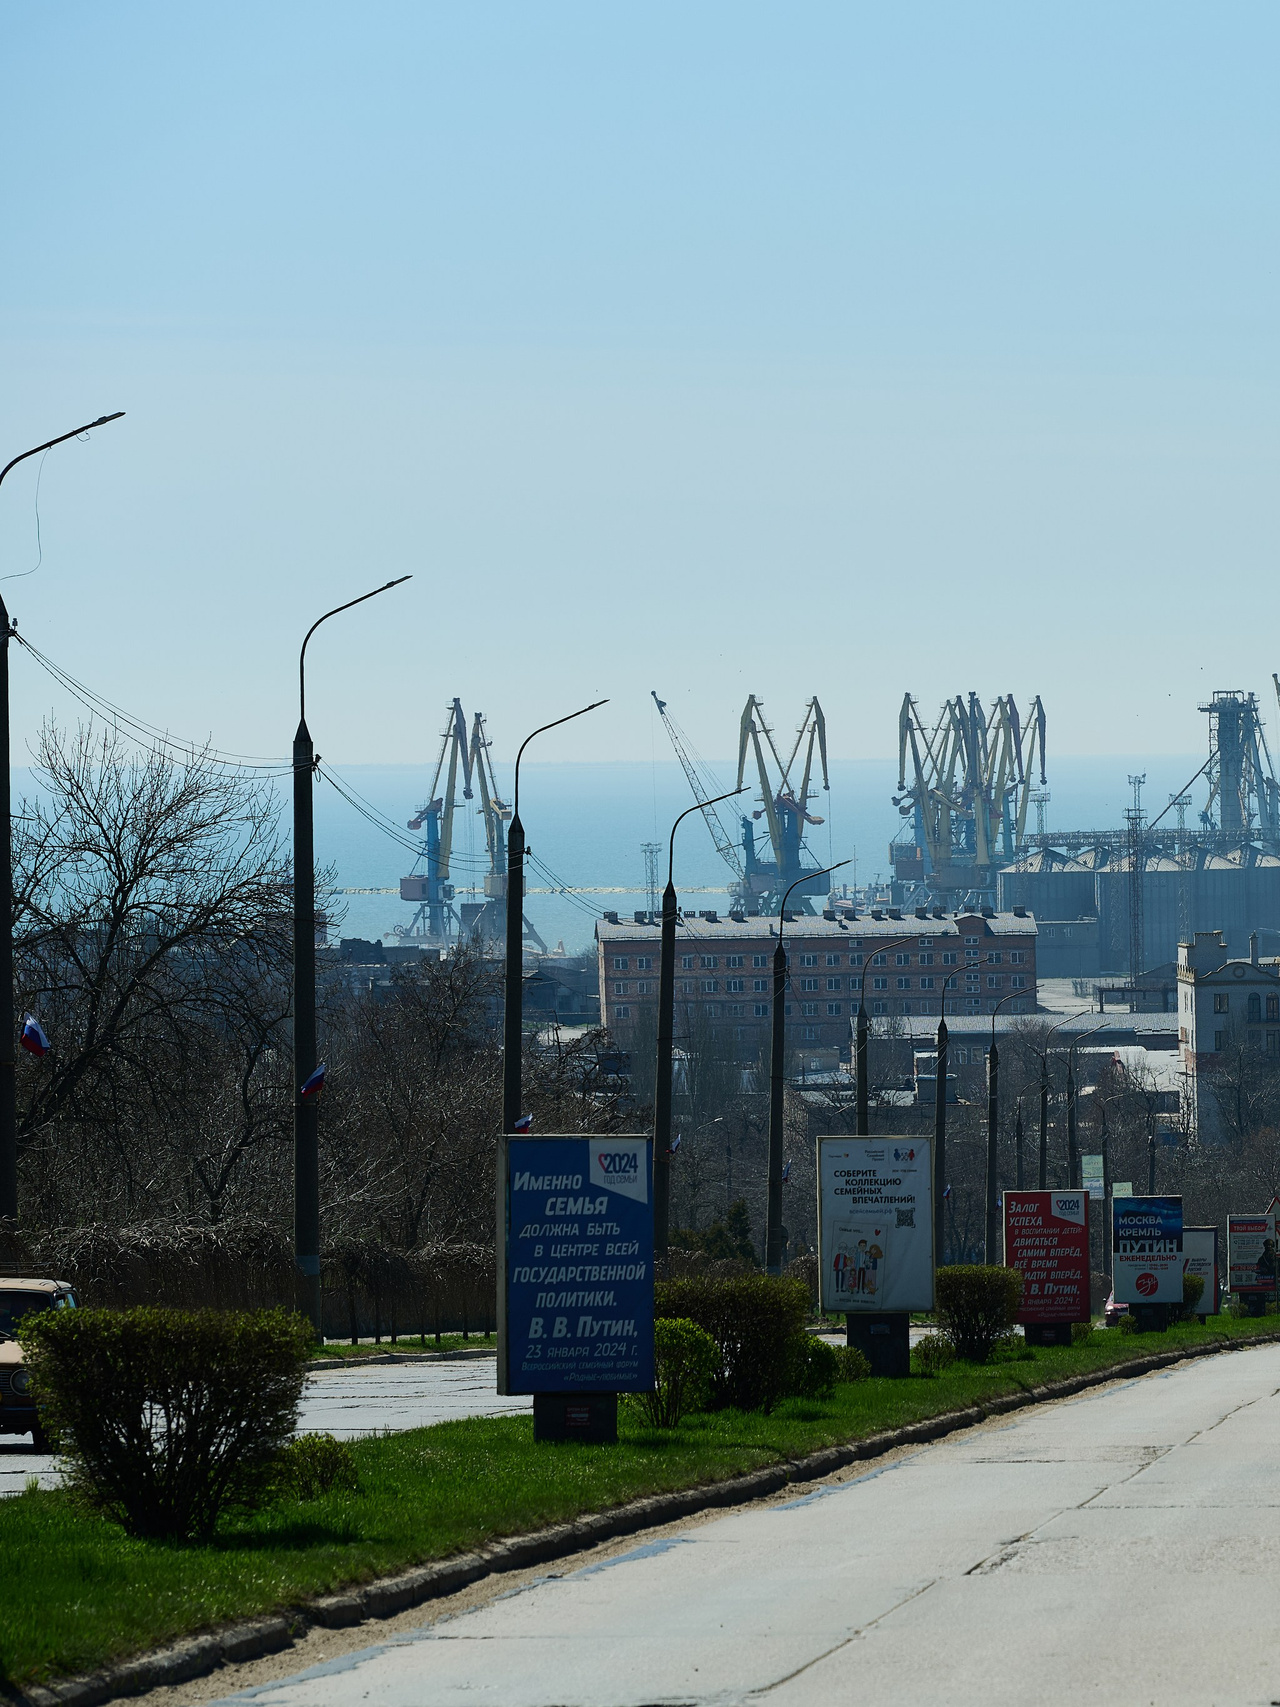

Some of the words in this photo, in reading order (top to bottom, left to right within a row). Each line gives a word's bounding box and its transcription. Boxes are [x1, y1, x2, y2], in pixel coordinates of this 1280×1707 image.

[605, 1153, 638, 1173] 2024
[834, 1170, 877, 1178] СОБЕРИТЕ
[845, 1178, 901, 1187] КОЛЛЕКЦИЮ
[834, 1186, 882, 1195] СЕМЕЙНЫХ
[852, 1194, 915, 1204] ВПЕЧАТЛЕНИЙ!
[545, 1196, 608, 1216] СЕМЬЯ
[1060, 1200, 1080, 1210] 2024
[1008, 1216, 1043, 1226] УСПЕХА
[1118, 1216, 1163, 1225] МОСКВА
[519, 1224, 579, 1239] ДОЛЖНА
[586, 1222, 620, 1235] БЫТЬ
[1022, 1227, 1060, 1235] ВОСПИТАНИИ
[1119, 1228, 1162, 1237] КРЕМЛЬ
[1013, 1237, 1058, 1247] ДВИГАТЬСЯ
[1119, 1239, 1177, 1253] ПУТИН
[534, 1245, 543, 1257] В
[550, 1244, 600, 1258] ЦЕНТРЕ
[605, 1240, 639, 1256] ВСЕЙ
[1017, 1249, 1046, 1258] САМИМ
[1014, 1259, 1028, 1269] ВСЁ
[1031, 1260, 1058, 1268] ВРЕМЯ
[513, 1261, 646, 1285] ГОСУДАРСТВЕННОЙ
[1024, 1271, 1047, 1281] ИДТИ
[1030, 1284, 1041, 1295] В.
[535, 1290, 617, 1308] ПОЛИТИКИ.
[1054, 1297, 1073, 1305] 2024
[528, 1317, 547, 1339] В.
[552, 1316, 572, 1338] В.
[526, 1345, 542, 1358] 23
[547, 1347, 589, 1358] ЯНВАРЯ
[594, 1342, 626, 1357] 2024
